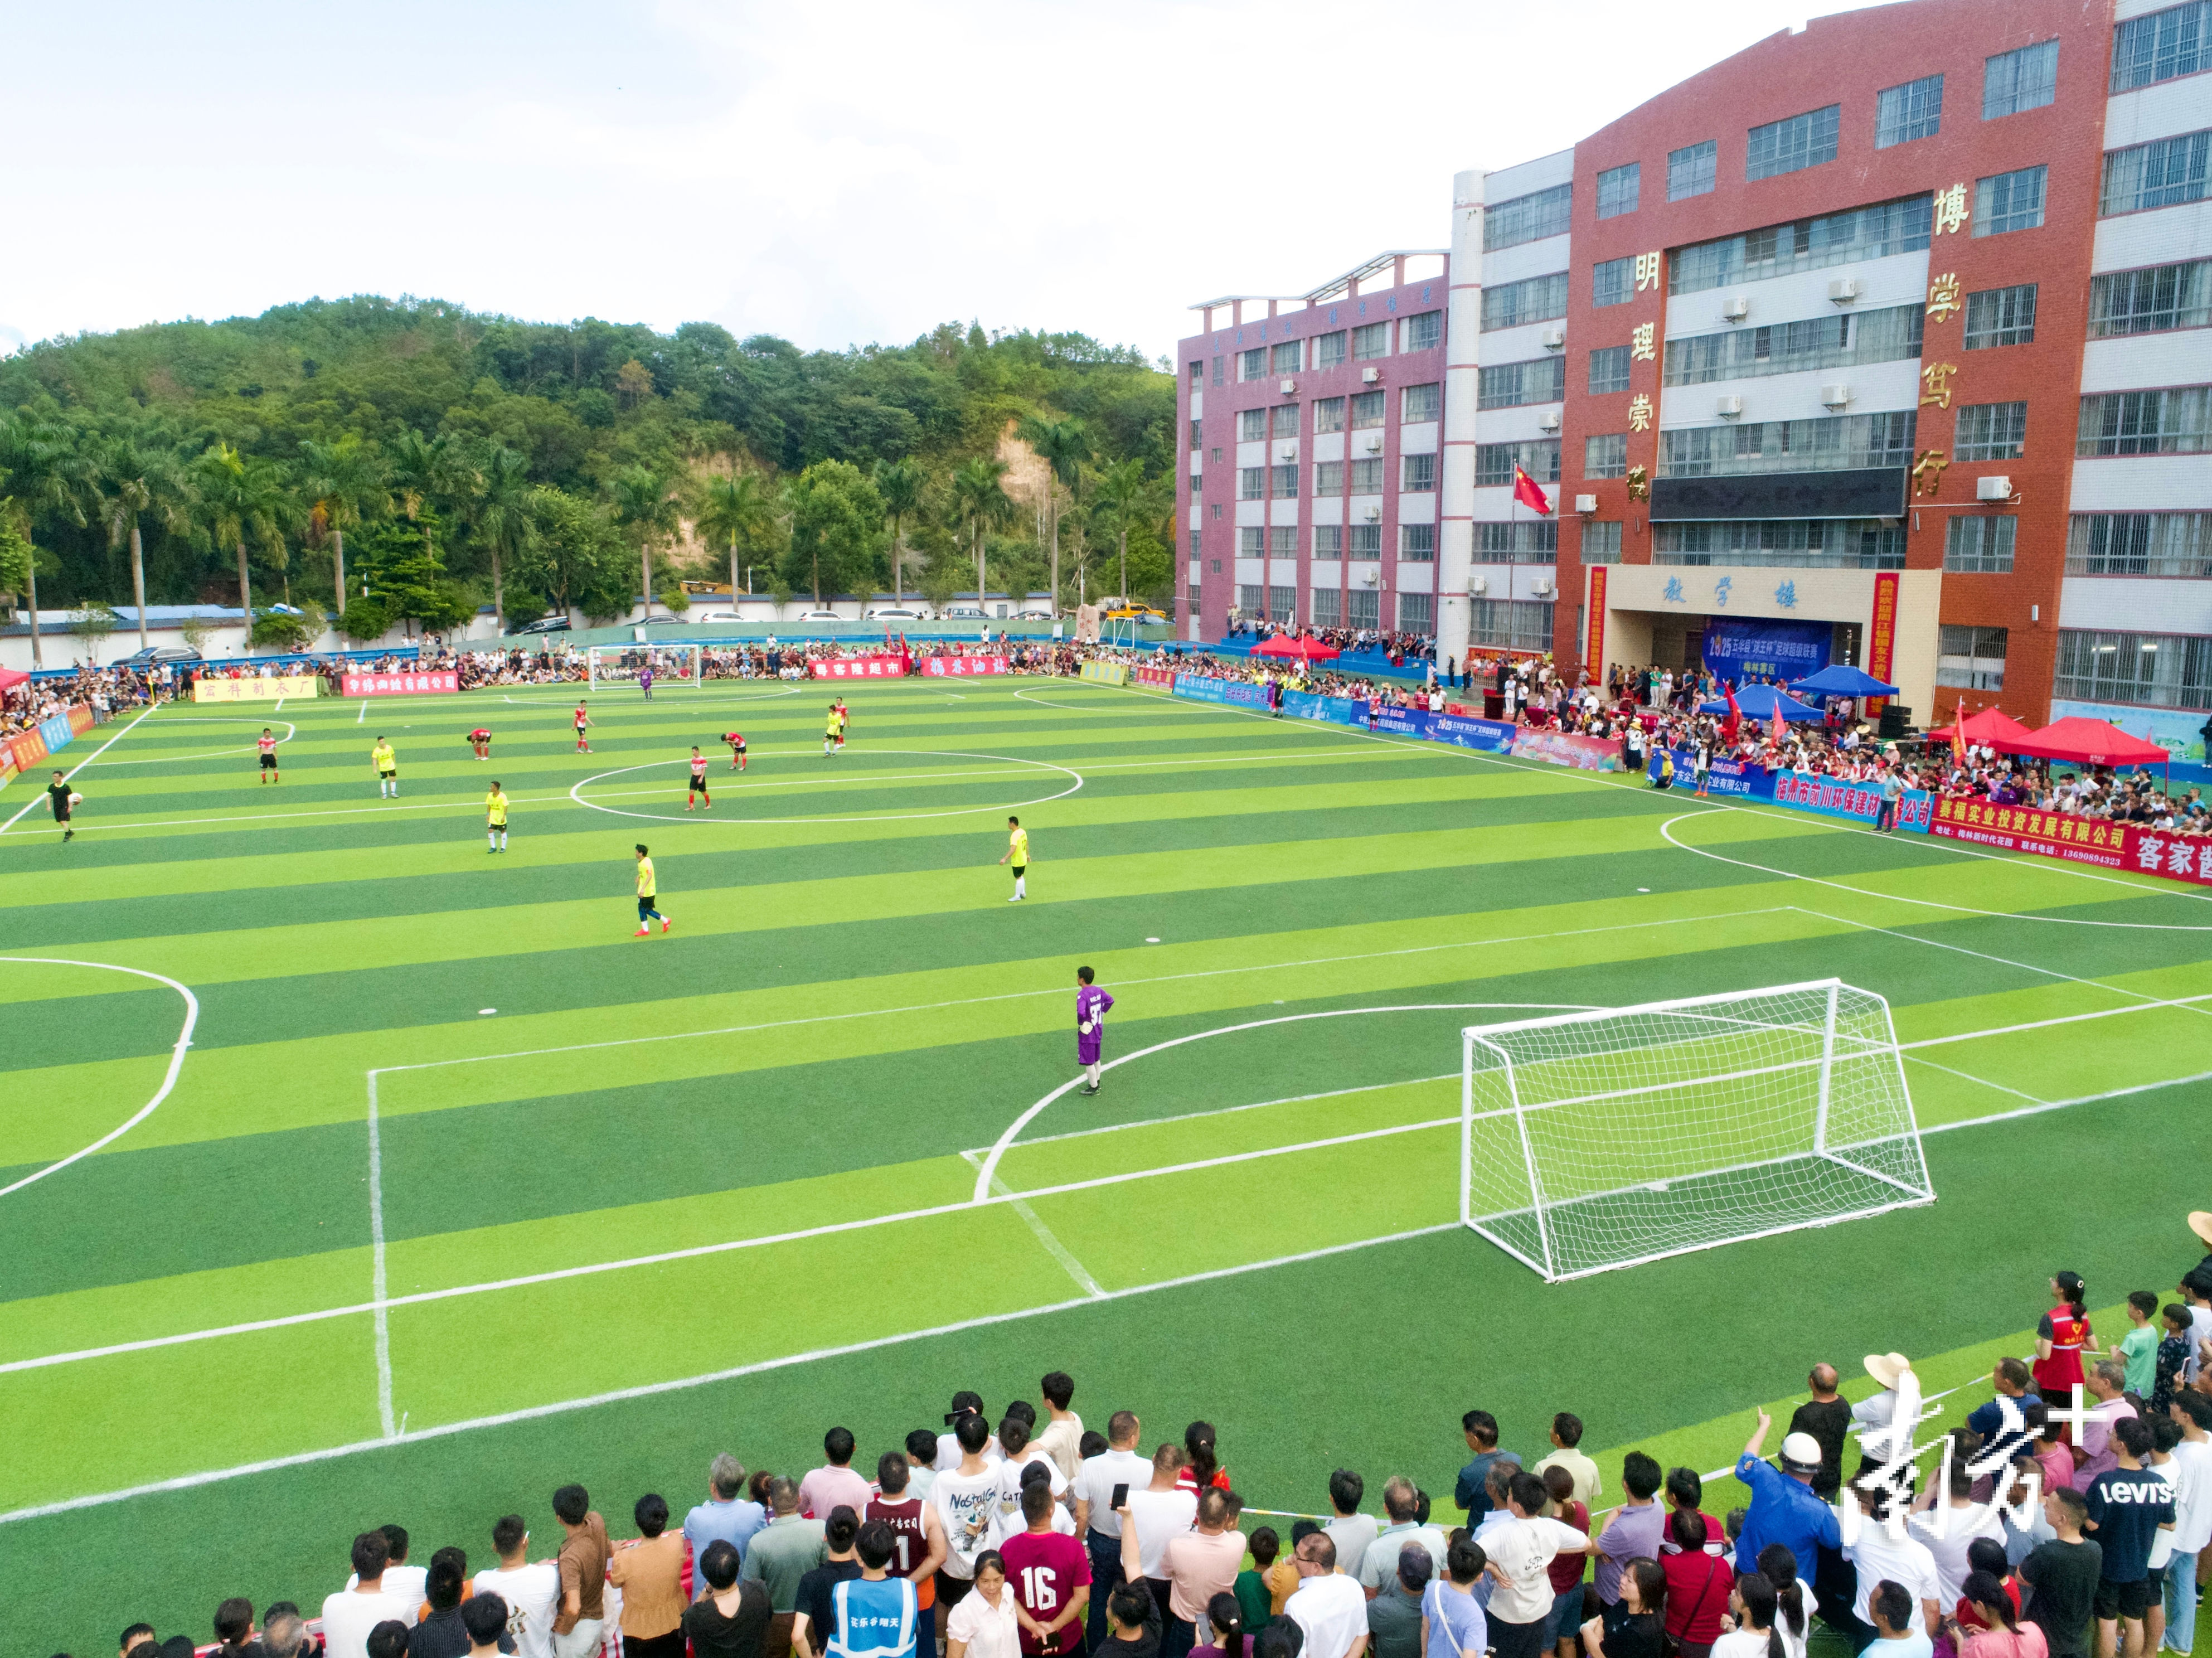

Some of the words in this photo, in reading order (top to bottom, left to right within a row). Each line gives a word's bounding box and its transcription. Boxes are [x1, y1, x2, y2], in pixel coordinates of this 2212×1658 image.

[1913, 183, 1970, 497] 博学笃行
[1663, 575, 1798, 609] 教学楼
[816, 661, 899, 676] 粤客隆超市
[204, 681, 309, 697] 宏祥制衣厂
[1020, 1566, 1056, 1611] 16
